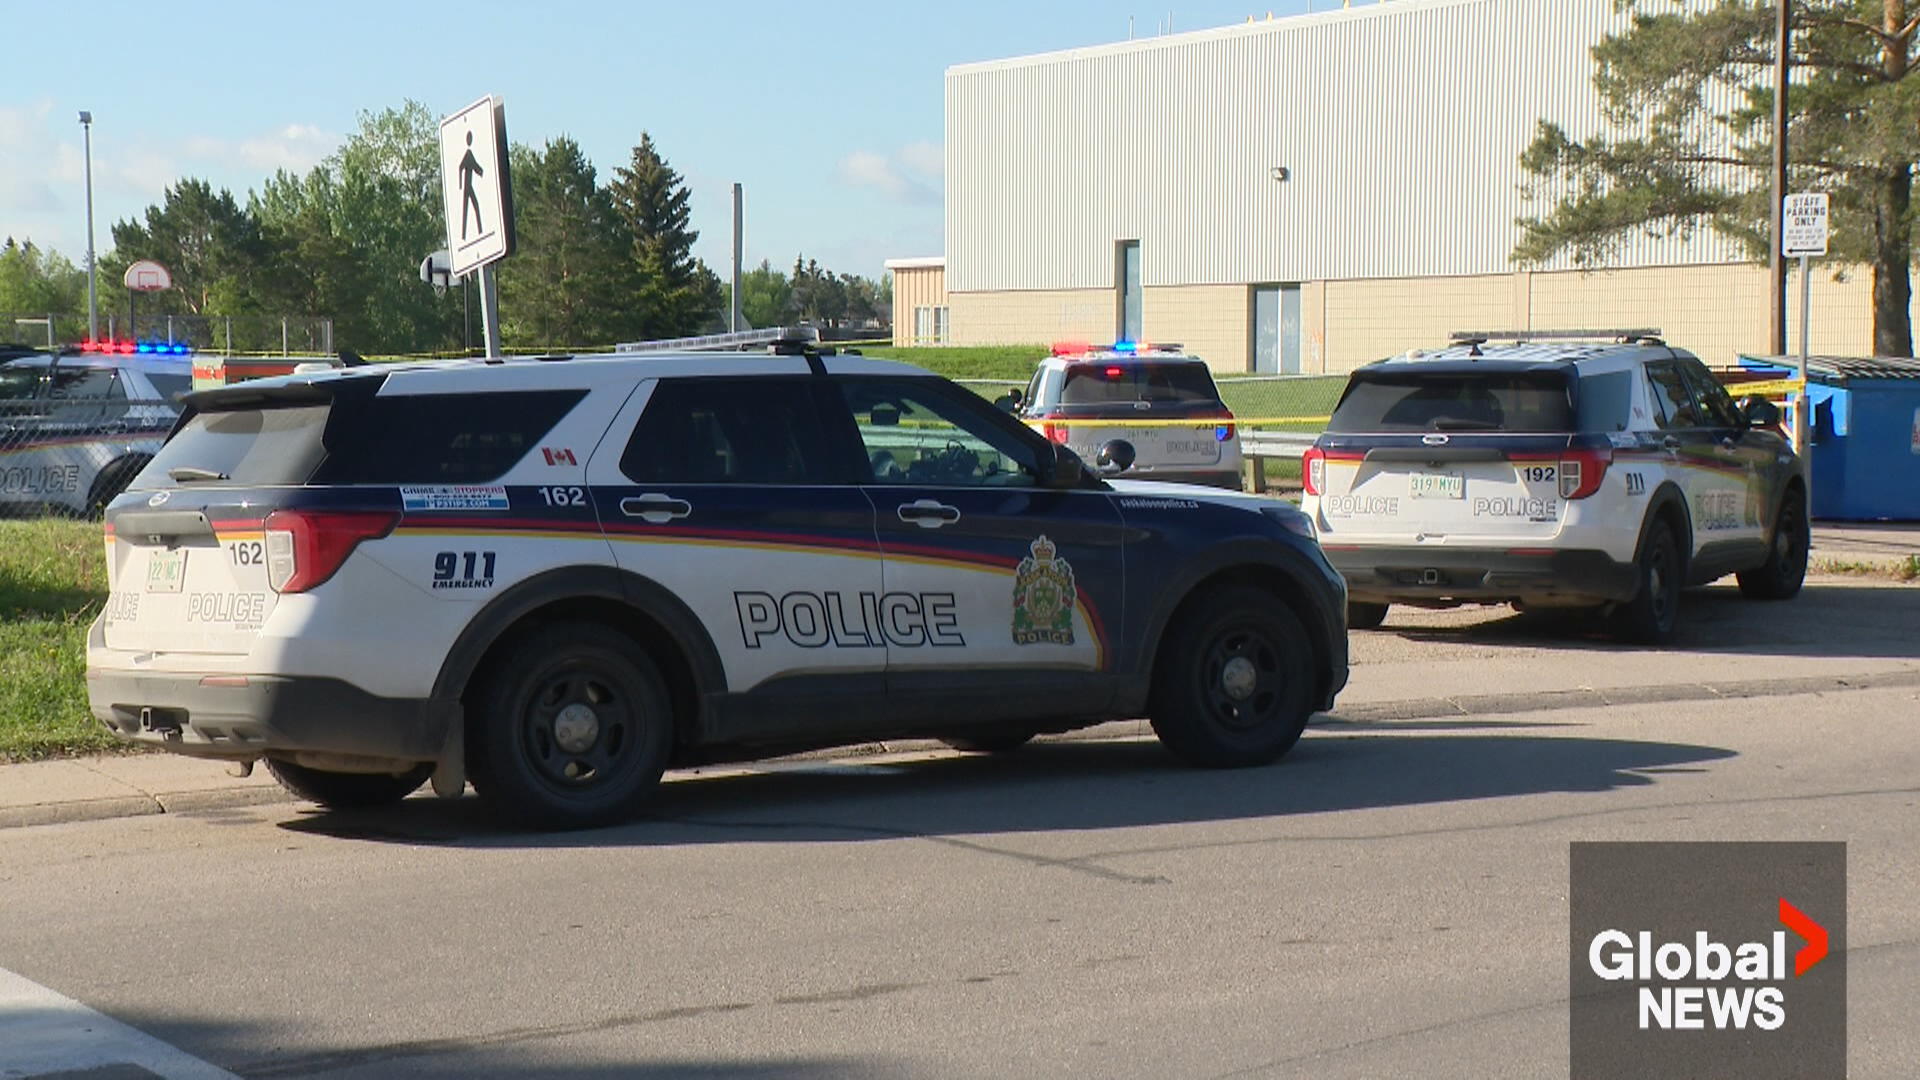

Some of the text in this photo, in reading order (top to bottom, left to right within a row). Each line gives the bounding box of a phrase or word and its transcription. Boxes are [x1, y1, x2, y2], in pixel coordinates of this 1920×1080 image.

[1792, 197, 1819, 206] STAFF
[1786, 207, 1826, 216] PARKING
[1794, 217, 1817, 226] ONLY
[1524, 466, 1556, 482] 192
[1625, 472, 1645, 490] 911
[1411, 477, 1433, 490] 319
[539, 487, 587, 506] 162
[1328, 495, 1399, 516] POLICE
[1473, 496, 1558, 517] POLICE
[1695, 493, 1738, 530] POLICE
[229, 541, 264, 566] 162
[434, 551, 496, 580] 911
[432, 579, 495, 589] EMERGENCY
[187, 593, 265, 622] POLICE
[734, 590, 967, 649] POLICE
[1017, 631, 1069, 644] POLICE
